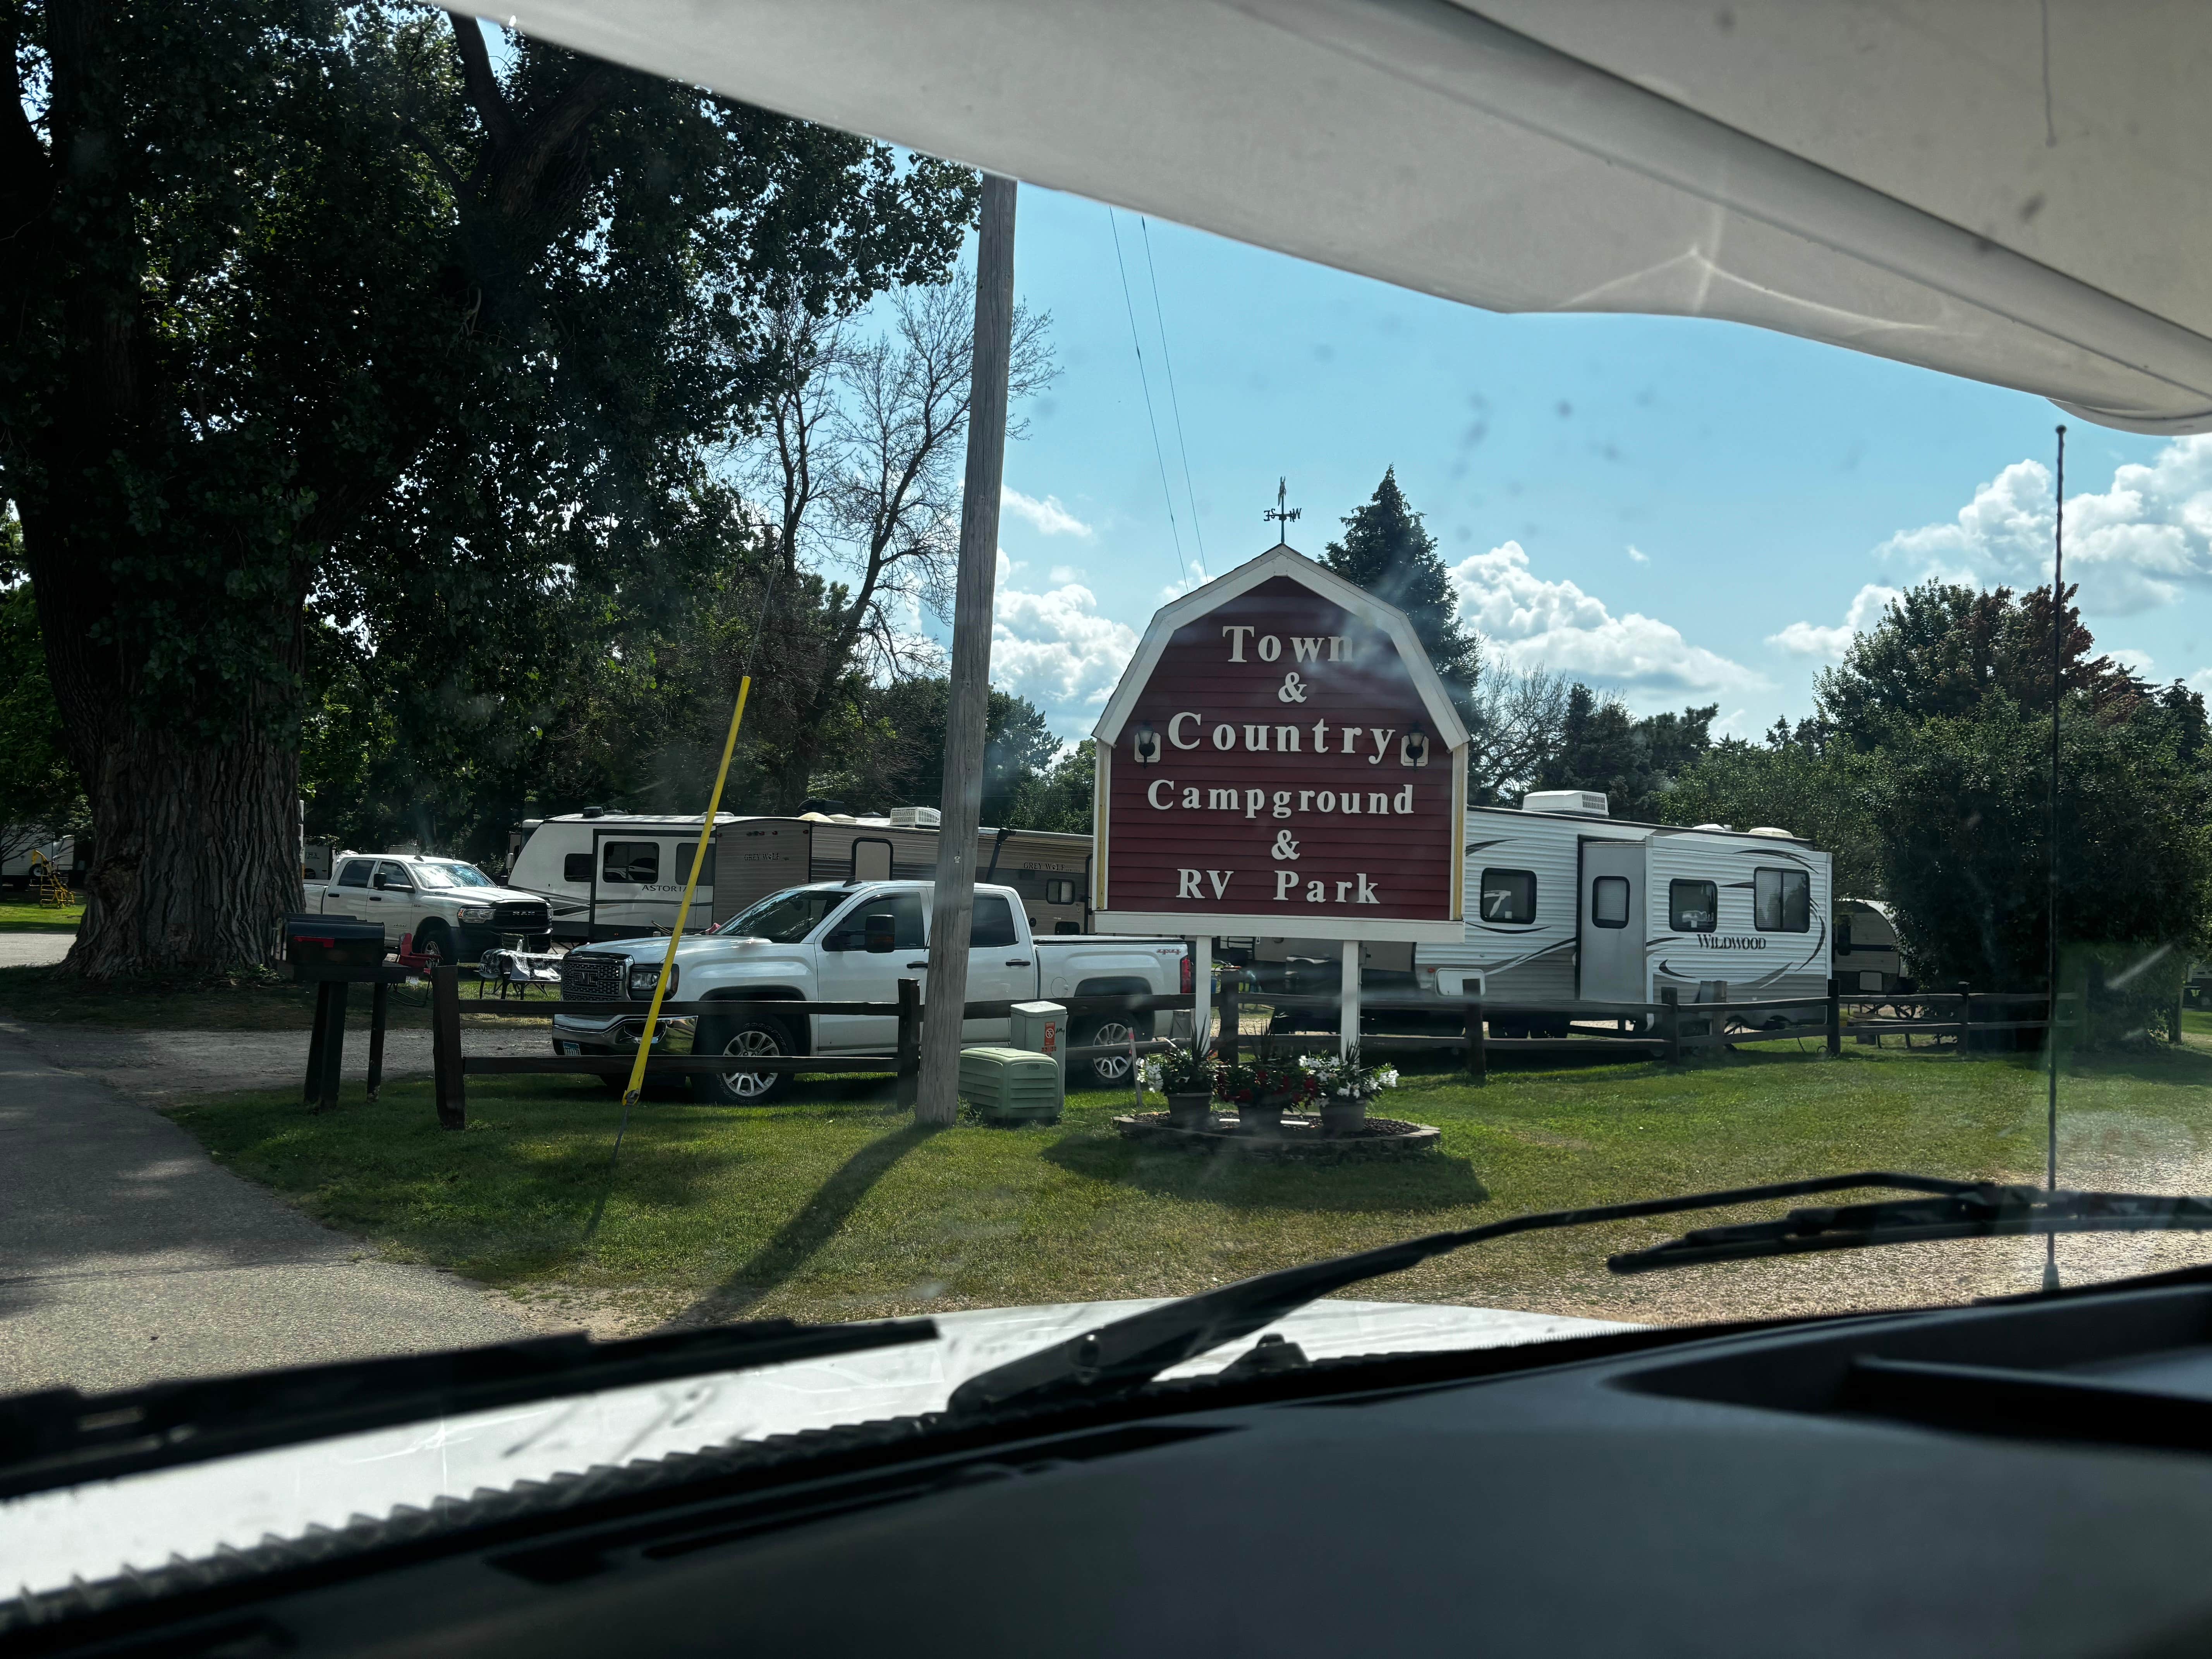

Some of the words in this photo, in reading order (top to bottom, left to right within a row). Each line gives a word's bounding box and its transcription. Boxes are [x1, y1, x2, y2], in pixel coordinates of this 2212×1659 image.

[1223, 626, 1353, 663] Town
[1278, 672, 1307, 703] &
[1168, 712, 1395, 764] Country
[1147, 779, 1414, 818] Campground
[1271, 829, 1300, 860] &
[1176, 868, 1234, 900] RV
[1273, 870, 1380, 904] Park
[574, 971, 598, 986] GMC
